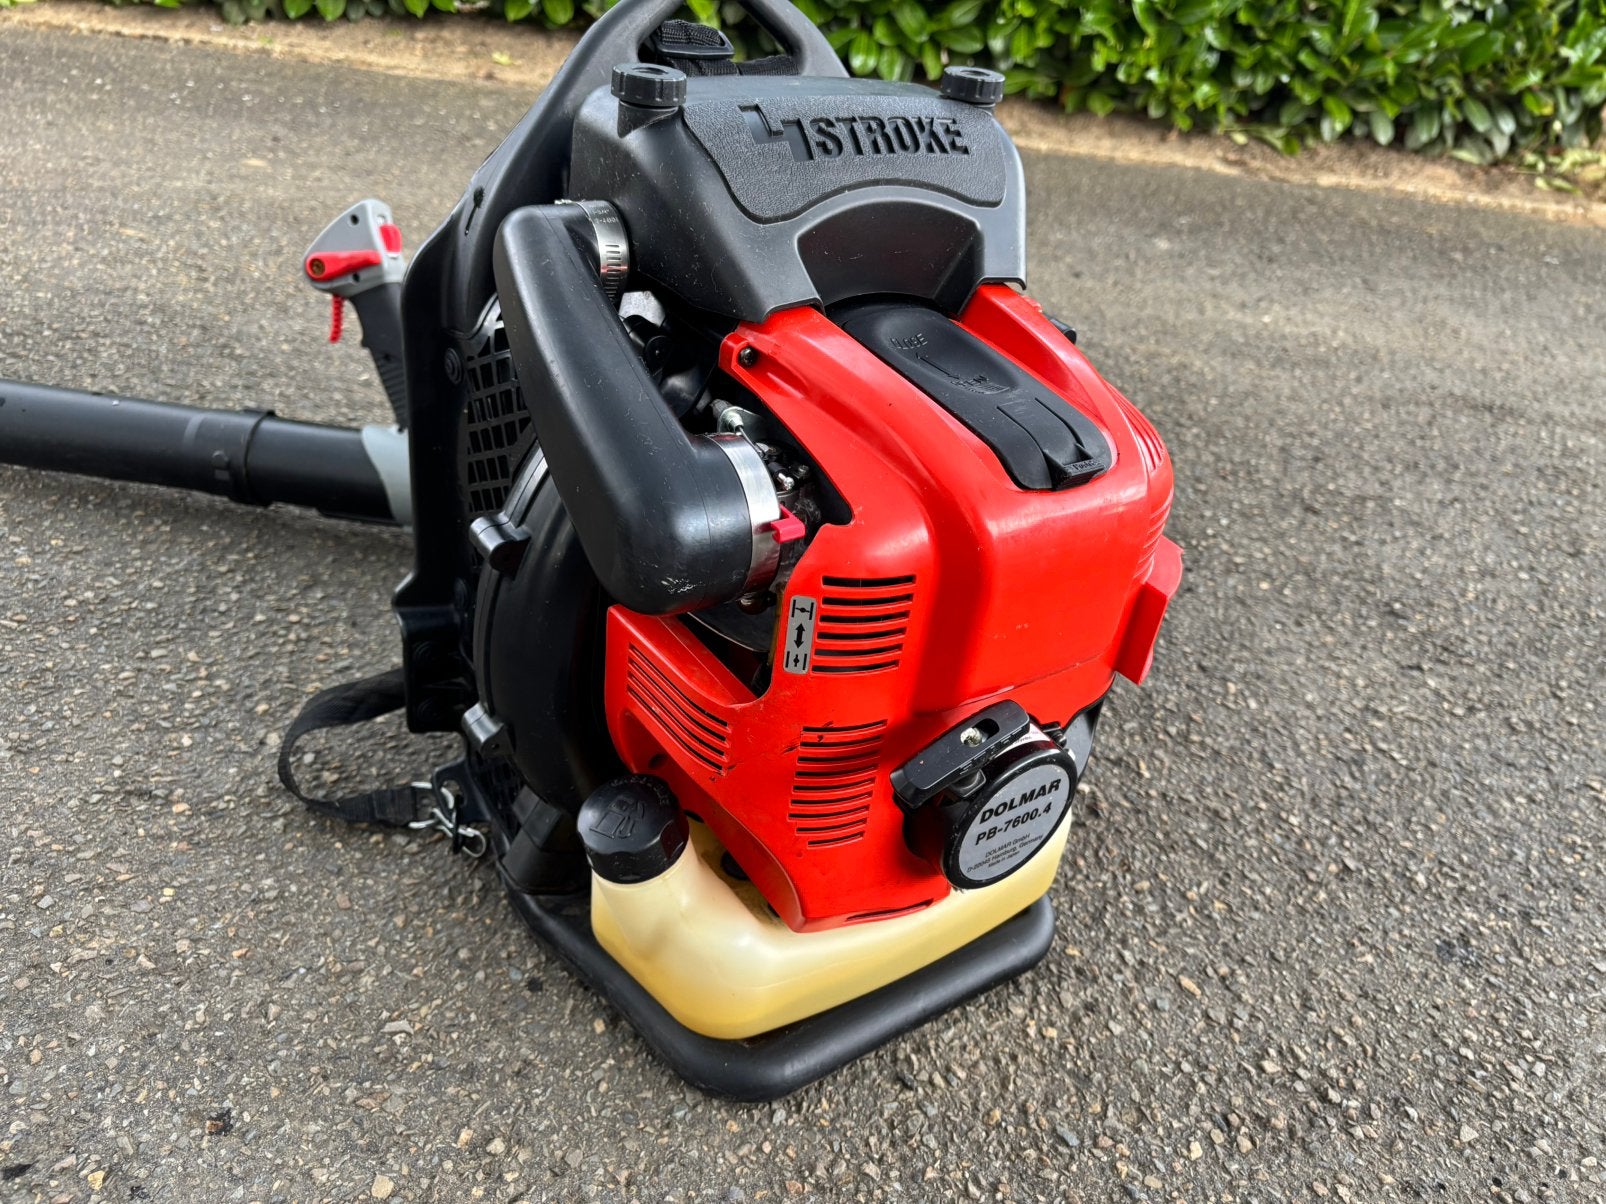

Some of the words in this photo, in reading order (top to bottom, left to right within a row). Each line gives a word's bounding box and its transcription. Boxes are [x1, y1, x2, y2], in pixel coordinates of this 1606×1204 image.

[809, 115, 970, 159] STROKE
[979, 779, 1062, 824] DOLMAR
[975, 802, 1053, 845] PB-7600.4
[985, 841, 1012, 858] DOLMAR
[1012, 833, 1031, 845] GmbH
